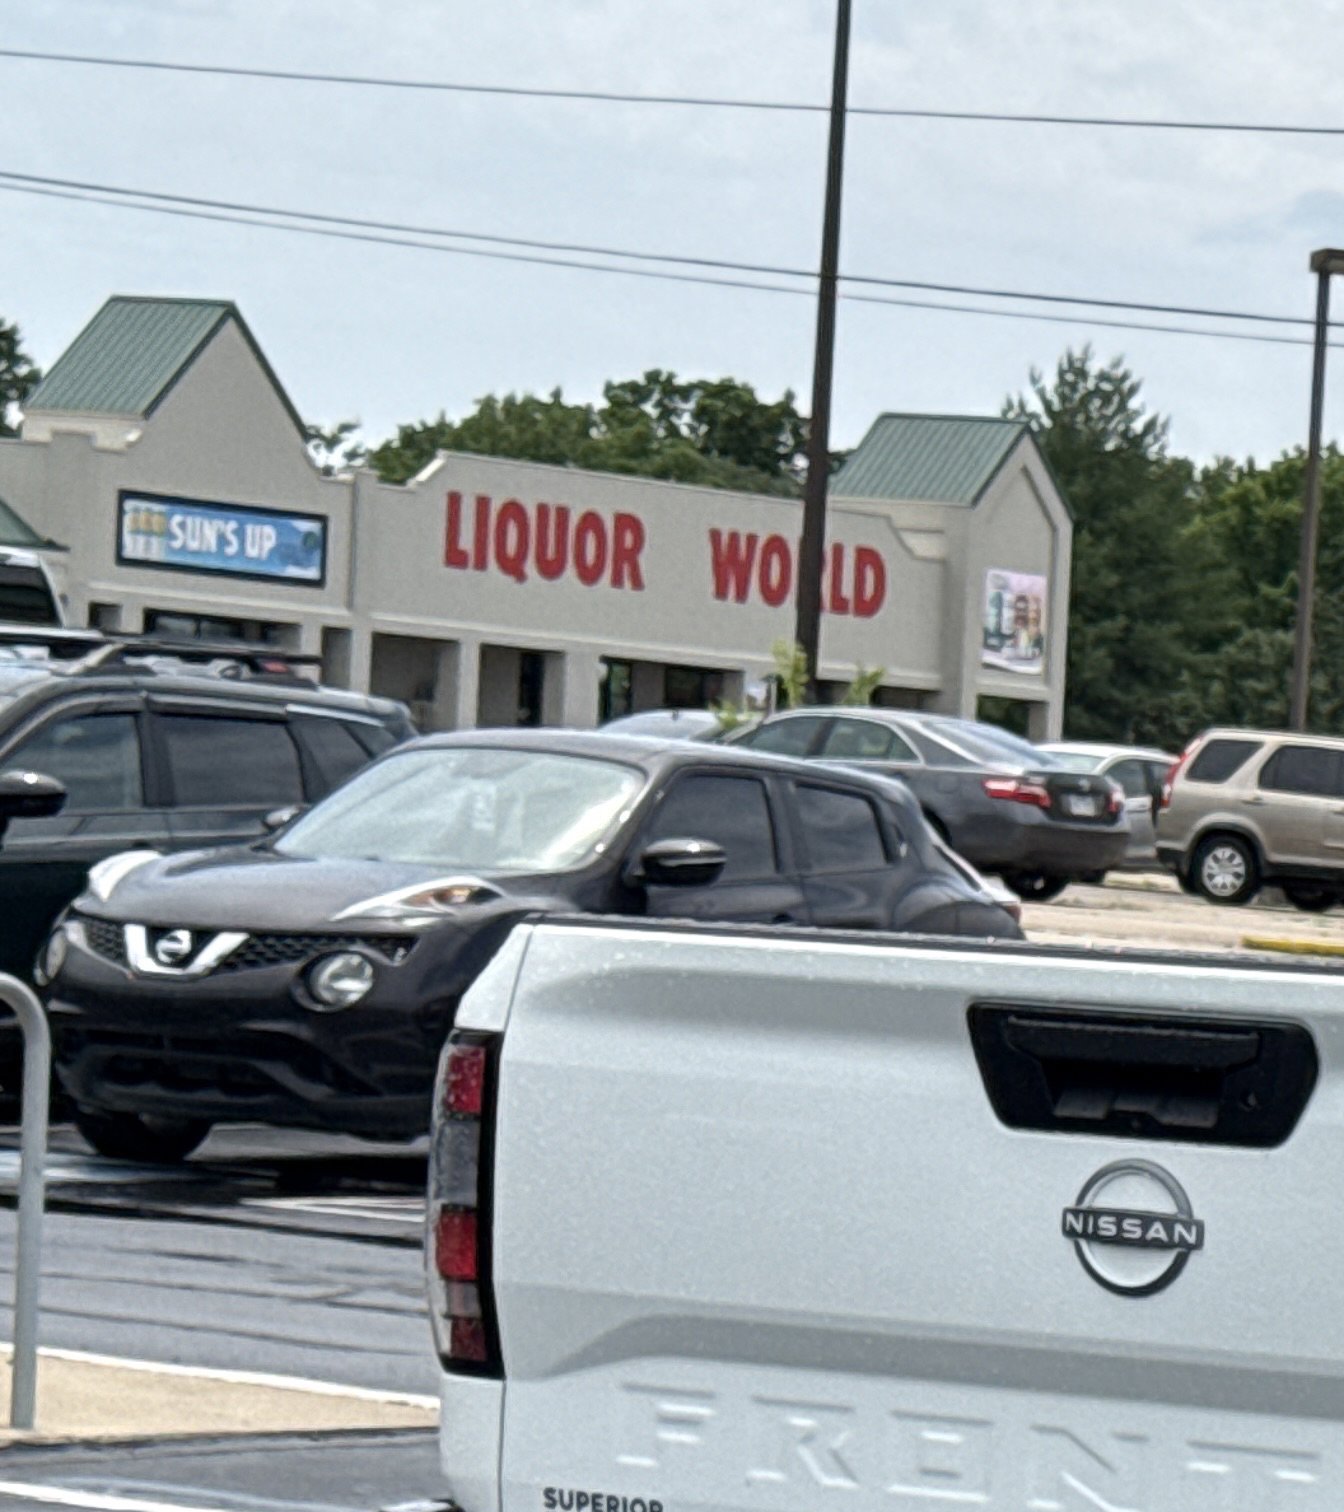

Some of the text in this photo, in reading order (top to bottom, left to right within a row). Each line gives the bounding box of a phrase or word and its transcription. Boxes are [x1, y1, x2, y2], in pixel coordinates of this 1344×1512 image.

[168, 514, 277, 560] SUN'S UP
[444, 490, 646, 592] LIQUOR
[709, 528, 886, 618] WOLD
[1065, 1212, 1198, 1246] NISSAN
